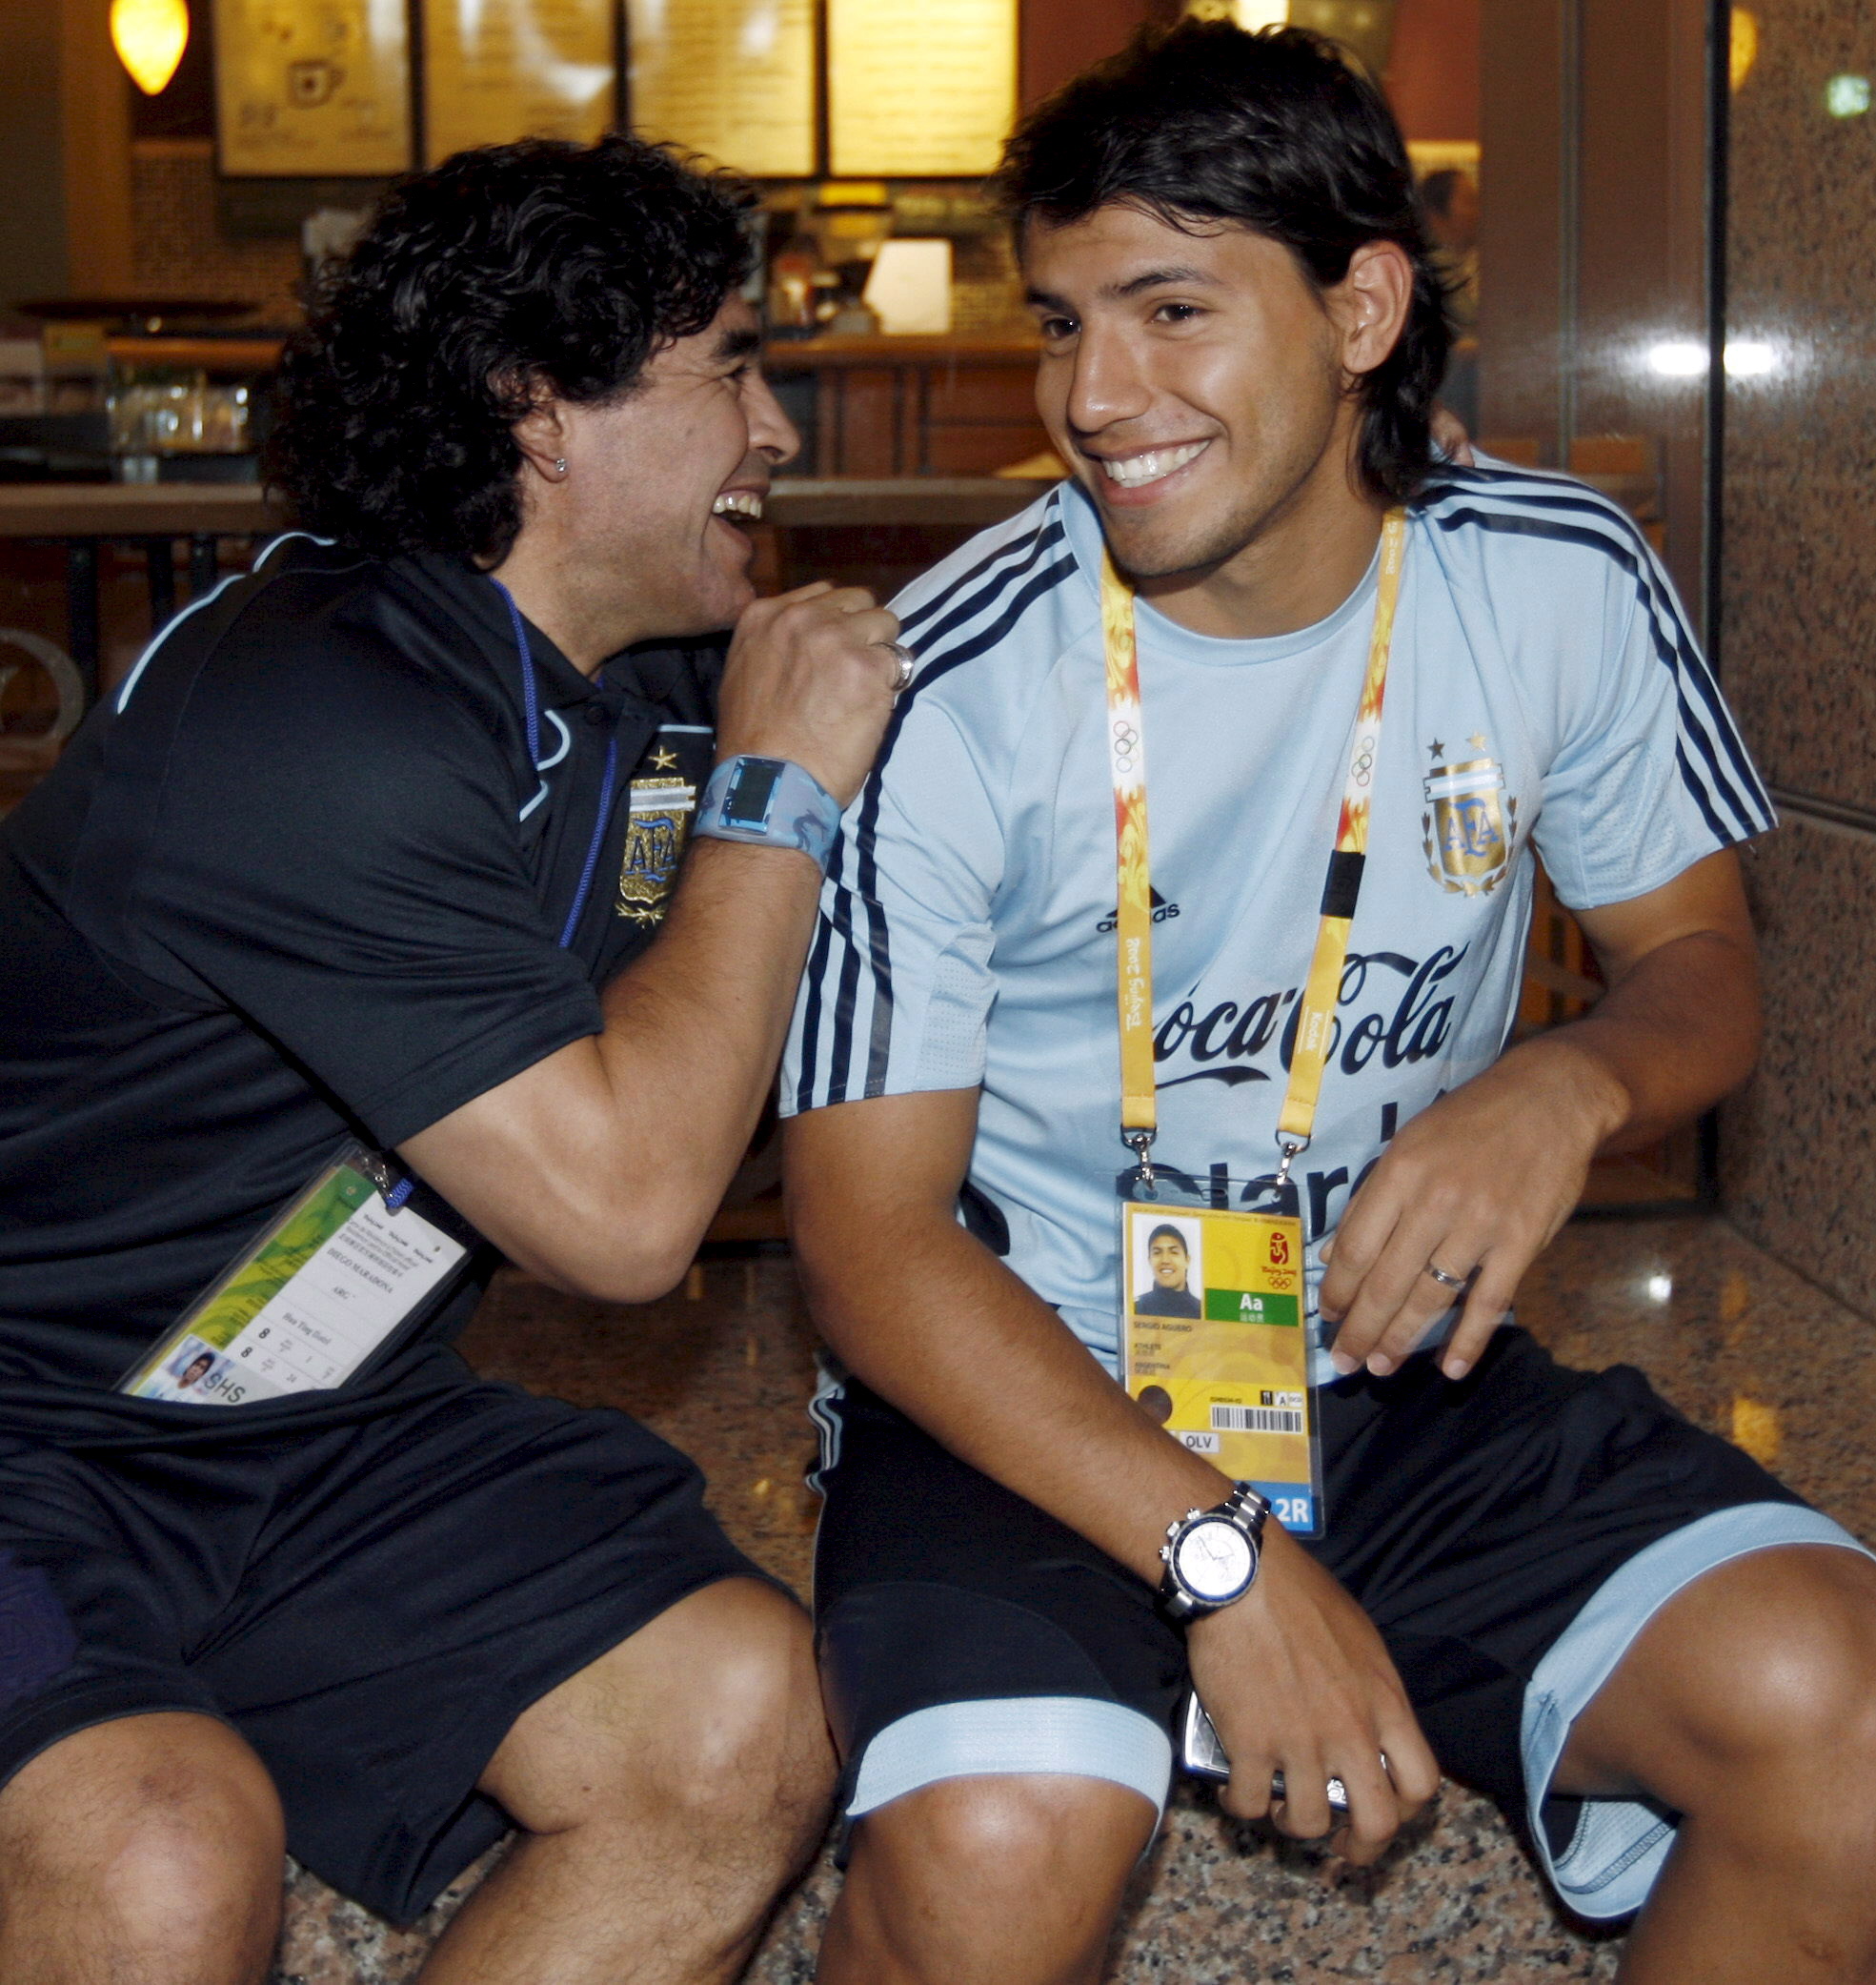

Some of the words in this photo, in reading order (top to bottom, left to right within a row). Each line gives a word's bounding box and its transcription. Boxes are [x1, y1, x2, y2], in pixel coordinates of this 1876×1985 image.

[1126, 937, 1140, 974] 2008
[1126, 978, 1145, 1032] Beijing
[1240, 1293, 1263, 1311] Aa
[258, 1327, 271, 1339] 8
[240, 1347, 253, 1358] 8
[204, 1372, 246, 1404] SHS
[1186, 1435, 1212, 1448] OLV
[1276, 1498, 1309, 1523] 2R
